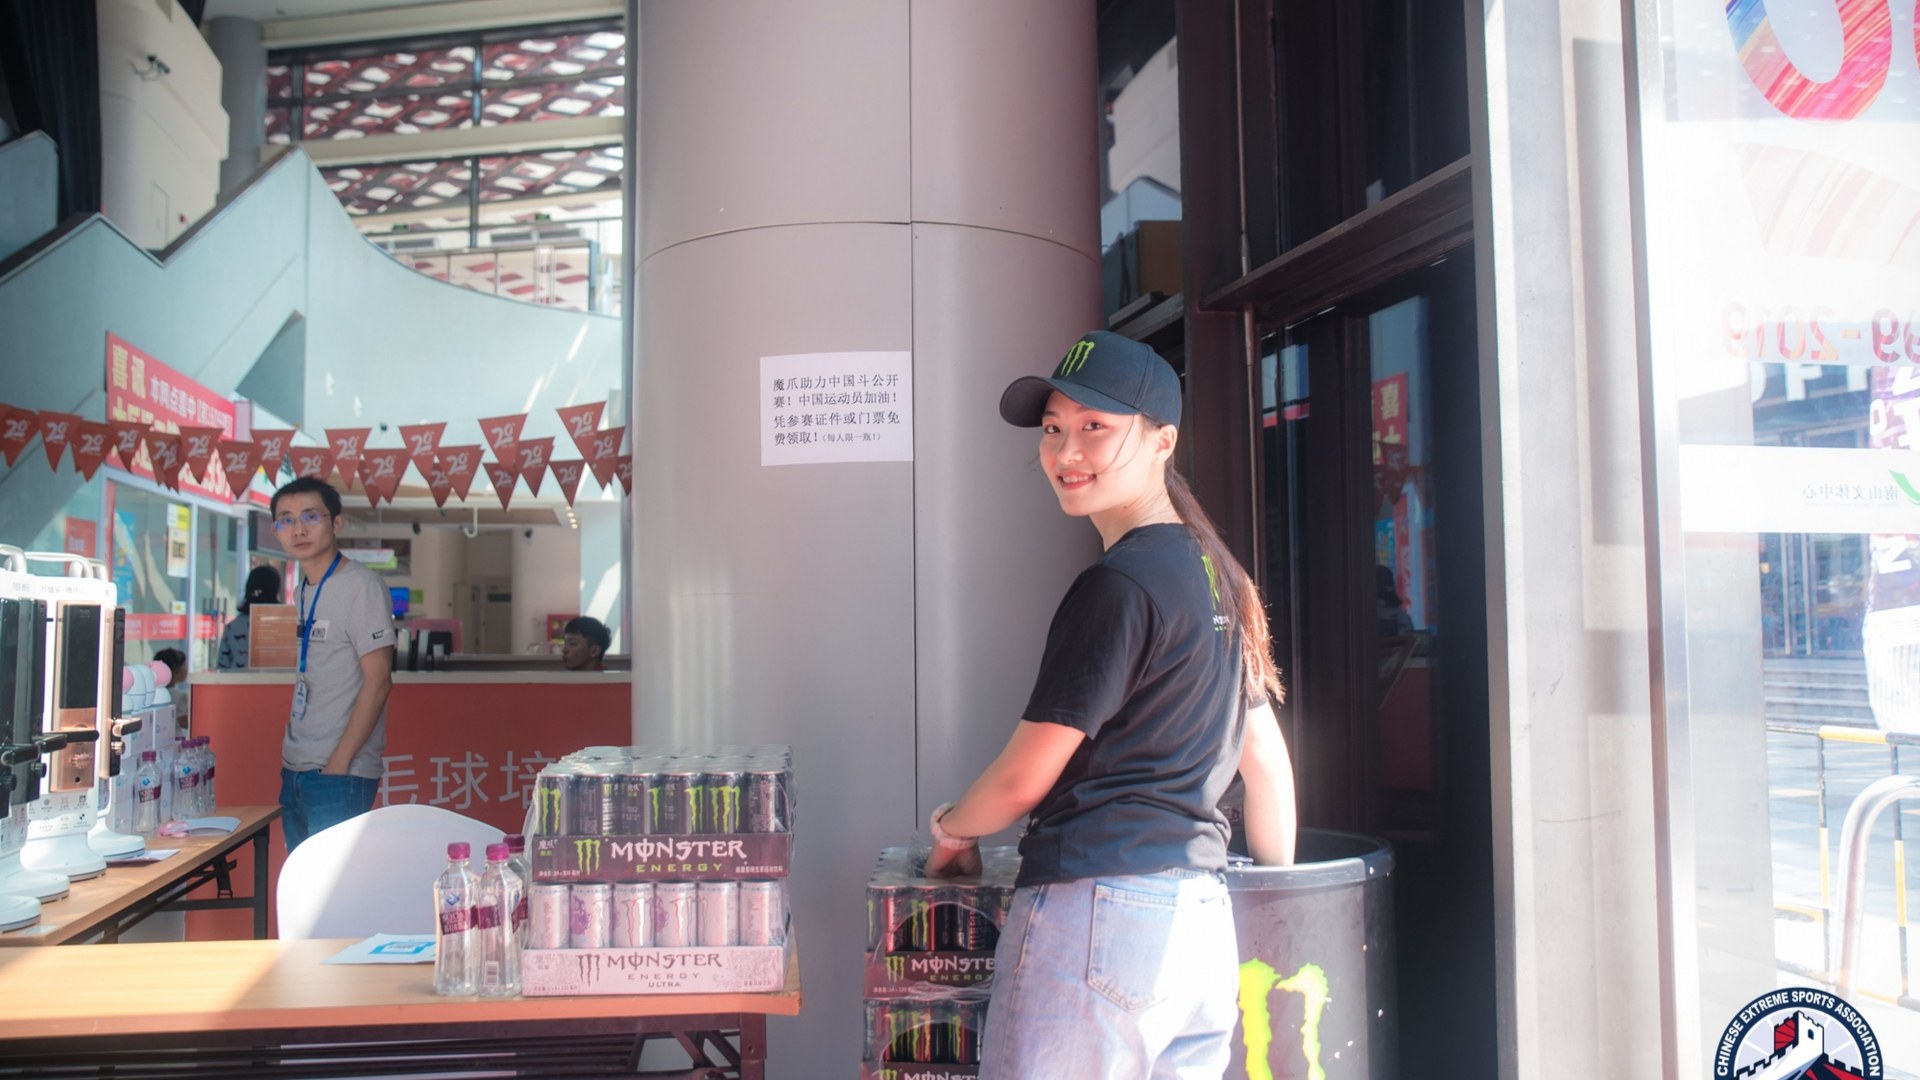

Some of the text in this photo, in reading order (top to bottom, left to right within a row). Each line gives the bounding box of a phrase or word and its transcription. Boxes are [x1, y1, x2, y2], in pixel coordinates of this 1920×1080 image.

[773, 374, 899, 391] 魔爪助力中国斗公开
[774, 411, 900, 428] 凭参赛证件或门票免
[611, 838, 747, 861] MONSTER
[636, 864, 722, 872] ENERGY
[607, 952, 722, 970] MONSTER
[911, 956, 995, 973] MONSTE
